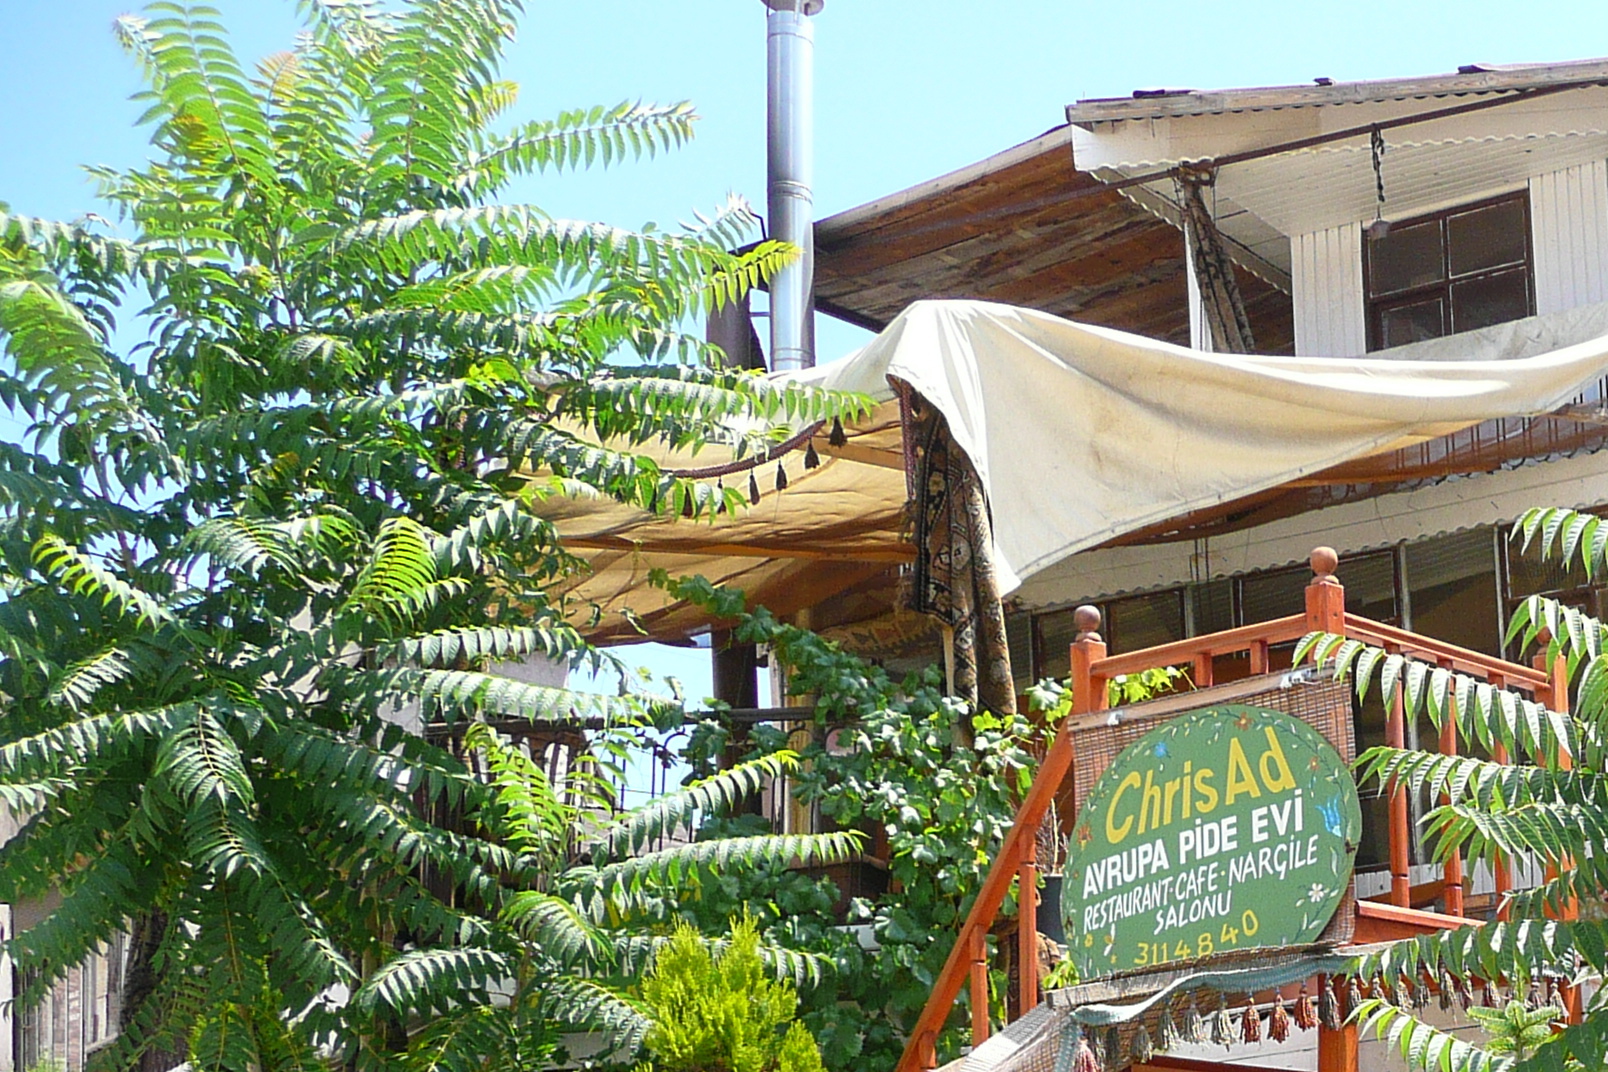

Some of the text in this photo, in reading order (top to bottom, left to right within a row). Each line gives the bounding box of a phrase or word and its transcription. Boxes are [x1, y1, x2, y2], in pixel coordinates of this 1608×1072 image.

[1083, 788, 1303, 899] AVRUPA PİDE EVİ
[1154, 889, 1232, 935] SALONU
